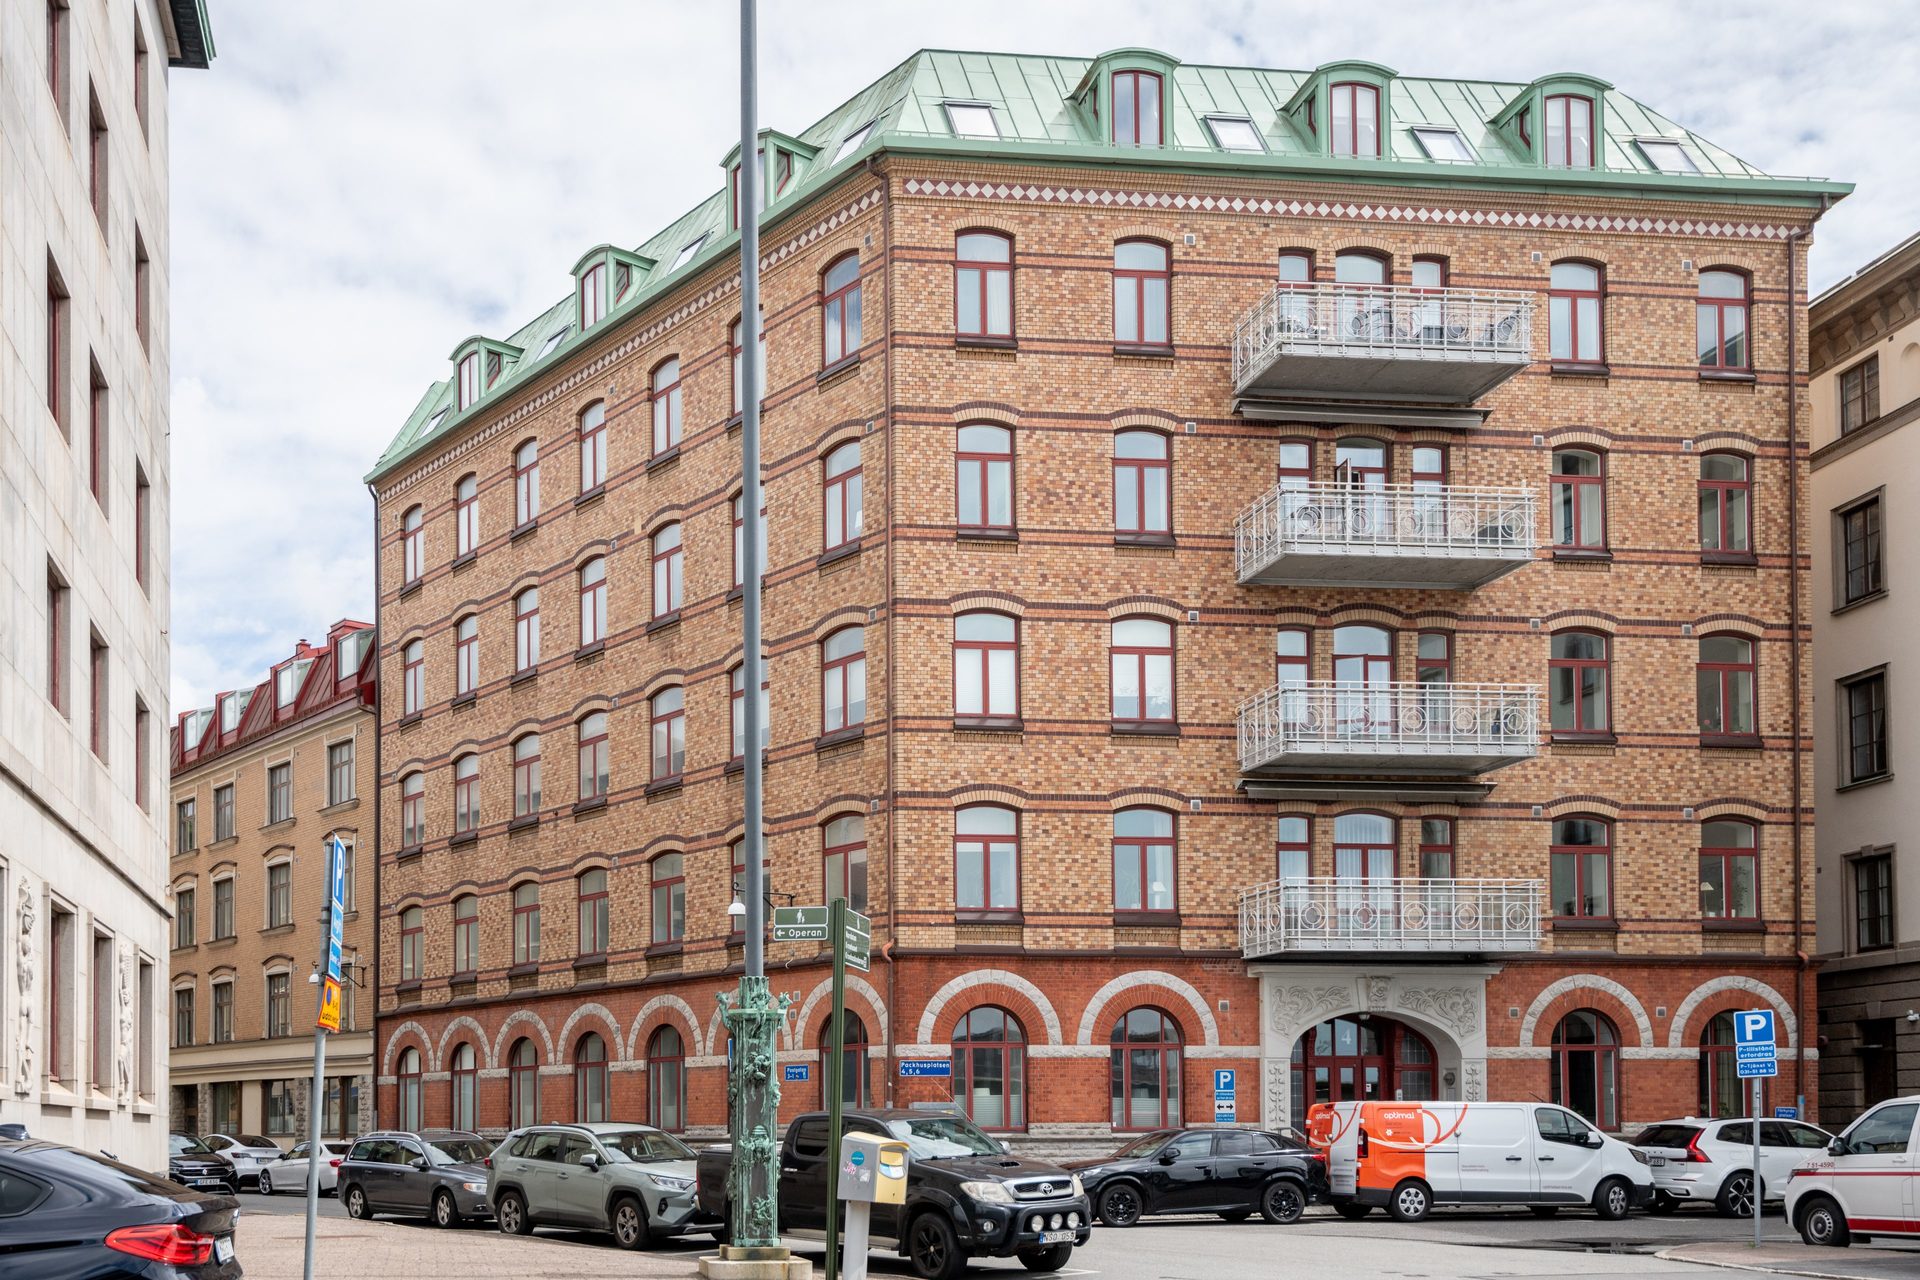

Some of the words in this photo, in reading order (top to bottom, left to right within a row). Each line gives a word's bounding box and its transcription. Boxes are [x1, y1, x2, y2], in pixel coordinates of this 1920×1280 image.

[336, 846, 343, 897] P
[788, 928, 822, 939] Operan
[1744, 1014, 1767, 1041] P
[1341, 1028, 1352, 1045] 4
[1738, 1045, 1774, 1053] P-tillstånd
[1220, 1071, 1232, 1089] P
[1315, 1112, 1331, 1120] optimal
[1383, 1111, 1415, 1120] optimal
